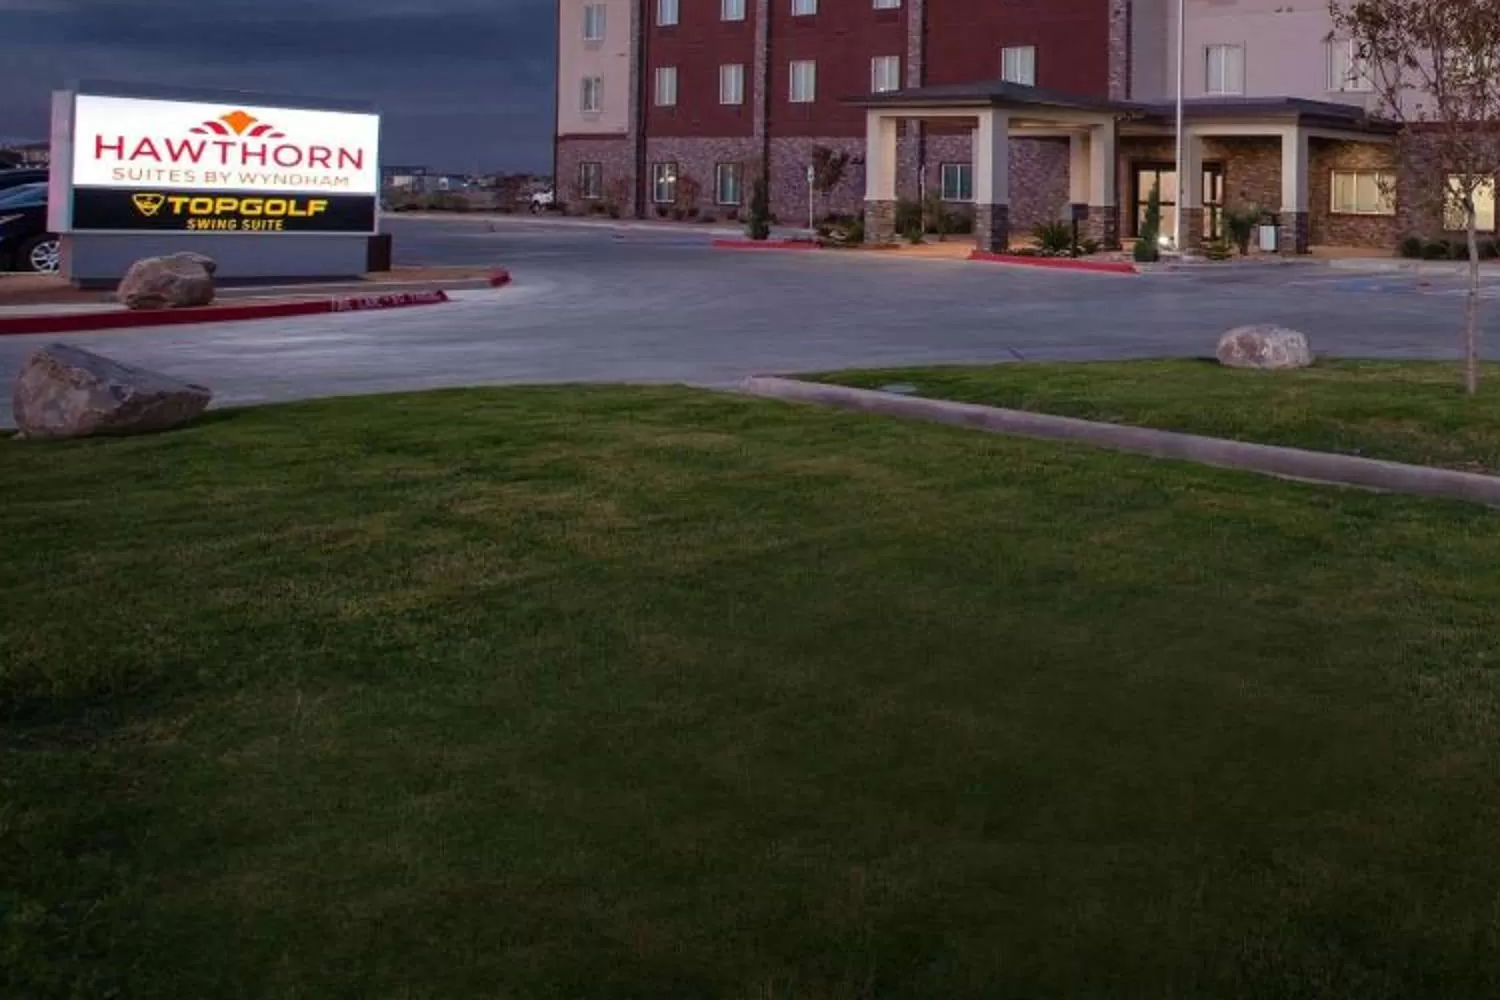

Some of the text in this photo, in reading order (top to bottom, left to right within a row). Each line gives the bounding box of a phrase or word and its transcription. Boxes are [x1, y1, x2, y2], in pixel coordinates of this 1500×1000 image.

[95, 134, 363, 169] HAWTHORN
[112, 167, 349, 187] SUITES BY WYNDHAM
[167, 196, 328, 217] TOPGOLF
[187, 218, 284, 231] SWING SUITE
